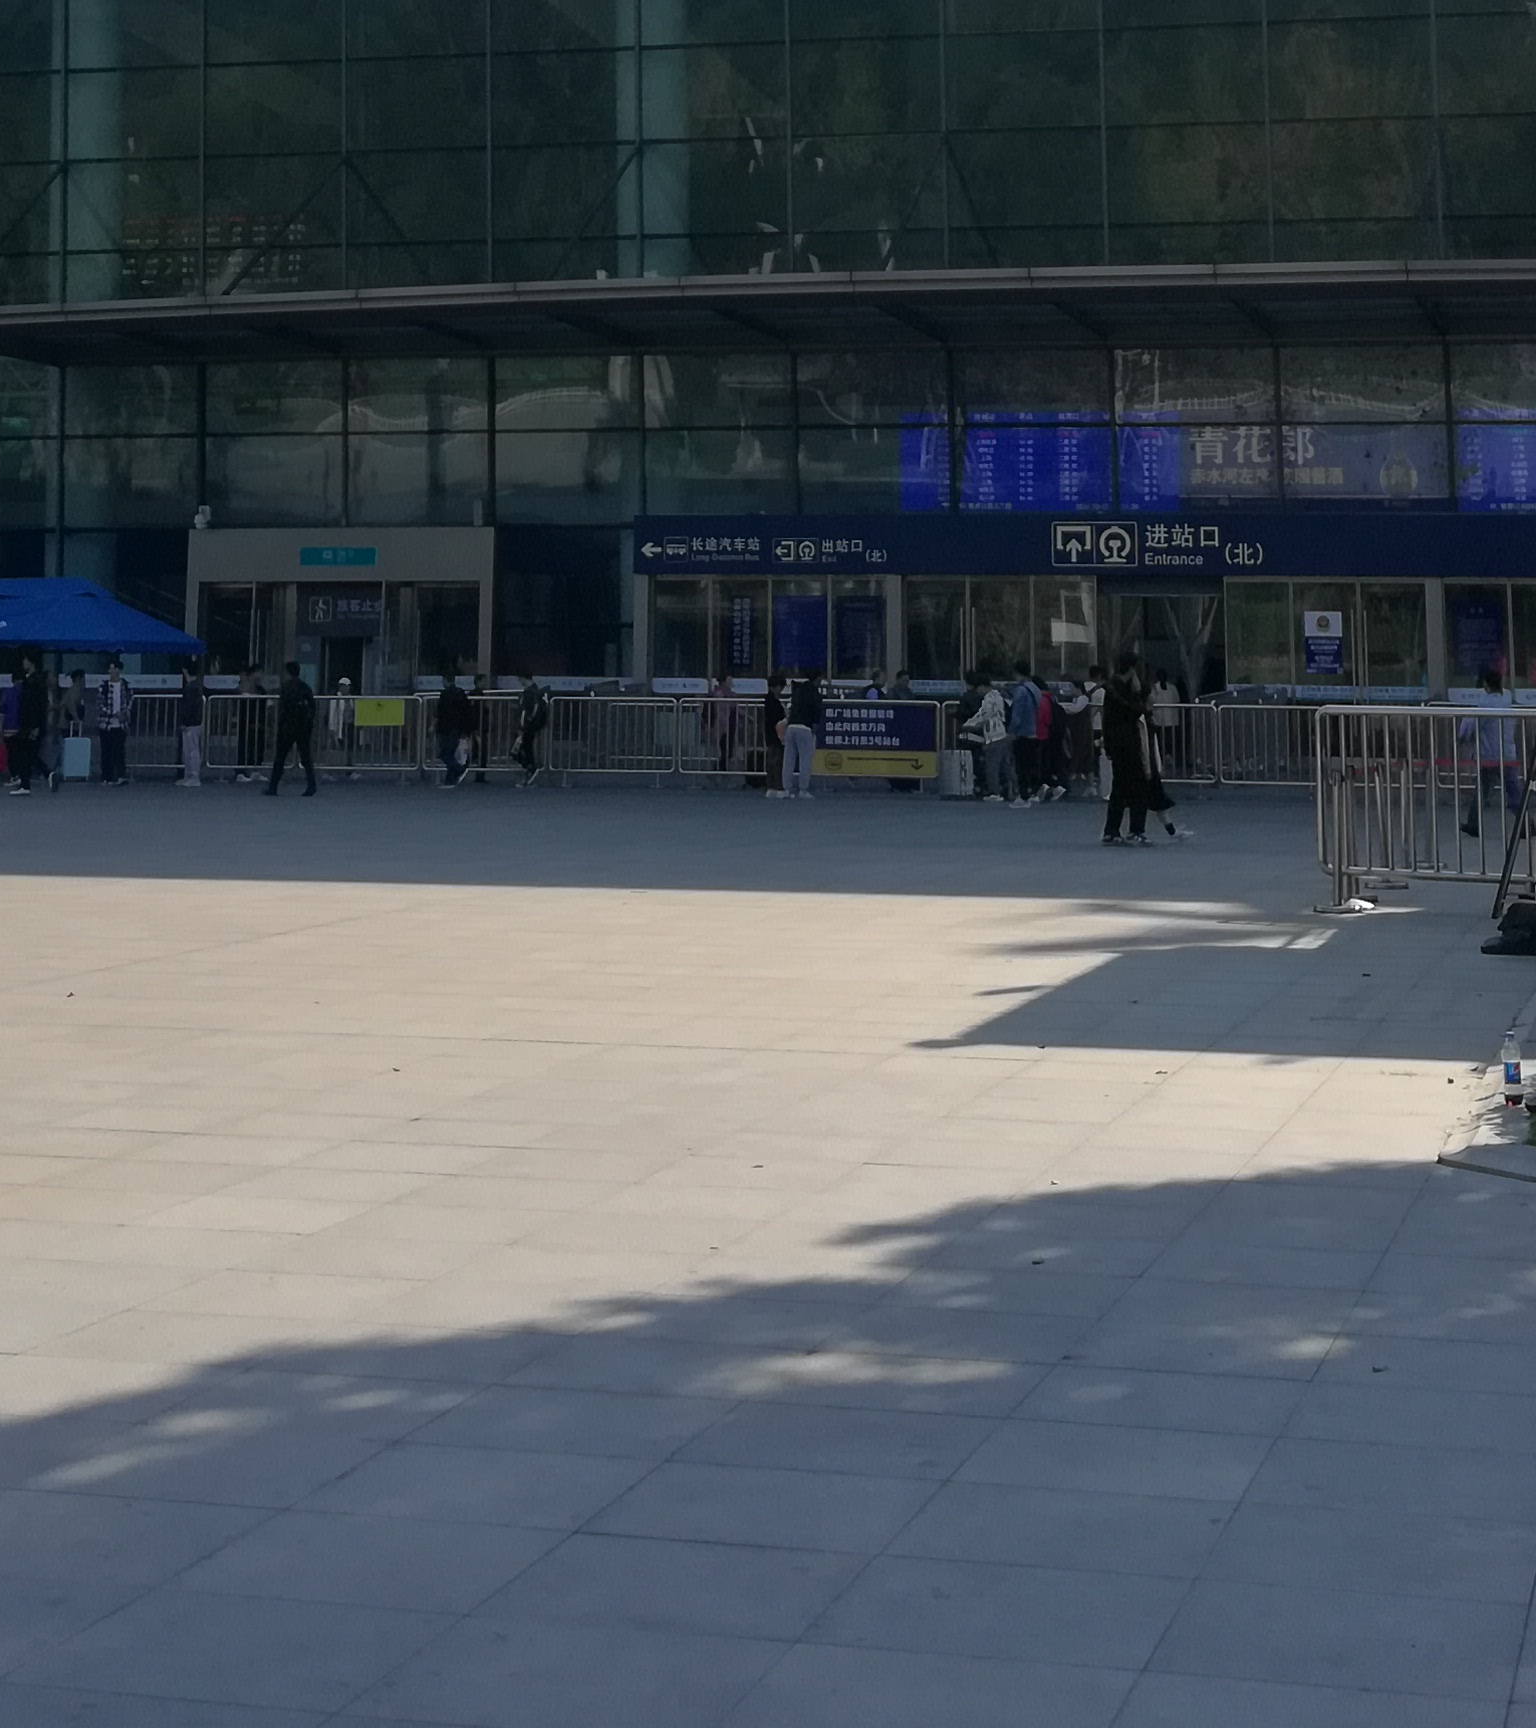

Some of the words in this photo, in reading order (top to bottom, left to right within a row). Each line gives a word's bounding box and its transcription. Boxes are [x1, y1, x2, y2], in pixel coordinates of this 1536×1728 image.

[1189, 425, 1315, 465] 青花郎
[1144, 523, 1220, 548] 进站口
[690, 536, 761, 552] 长途汽车站
[821, 538, 863, 553] 出站口
[1144, 552, 1204, 565] Entrance
